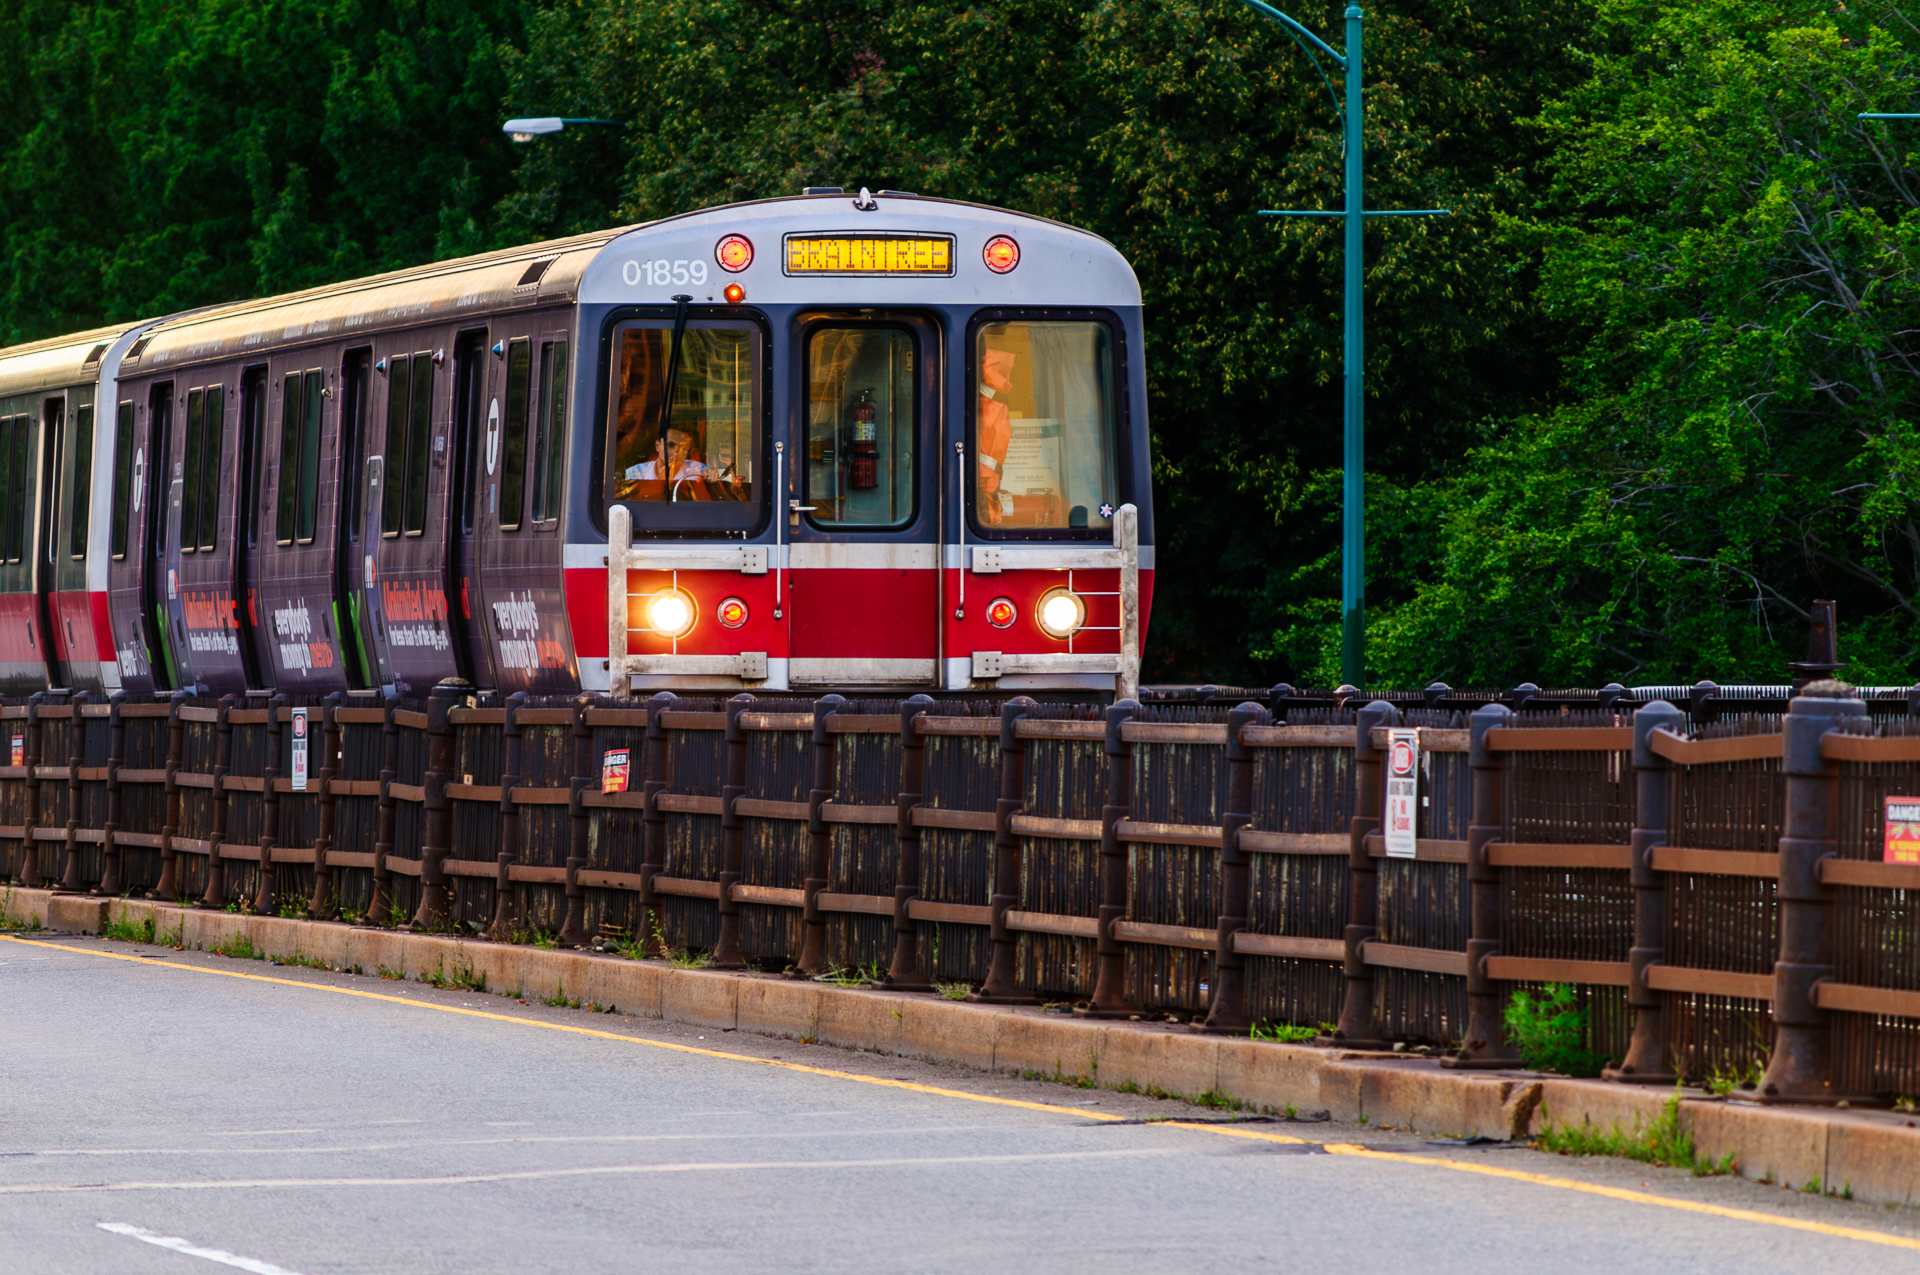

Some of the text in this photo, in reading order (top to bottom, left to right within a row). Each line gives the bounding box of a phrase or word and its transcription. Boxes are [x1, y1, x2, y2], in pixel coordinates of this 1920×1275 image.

[622, 259, 708, 286] 01859
[788, 239, 947, 270] BRAINTREE
[184, 591, 218, 629] Unlimited
[275, 597, 312, 642] everybody's
[383, 580, 423, 621] Unlimited
[280, 635, 334, 676] moving to metro
[499, 632, 566, 677] moving to metro
